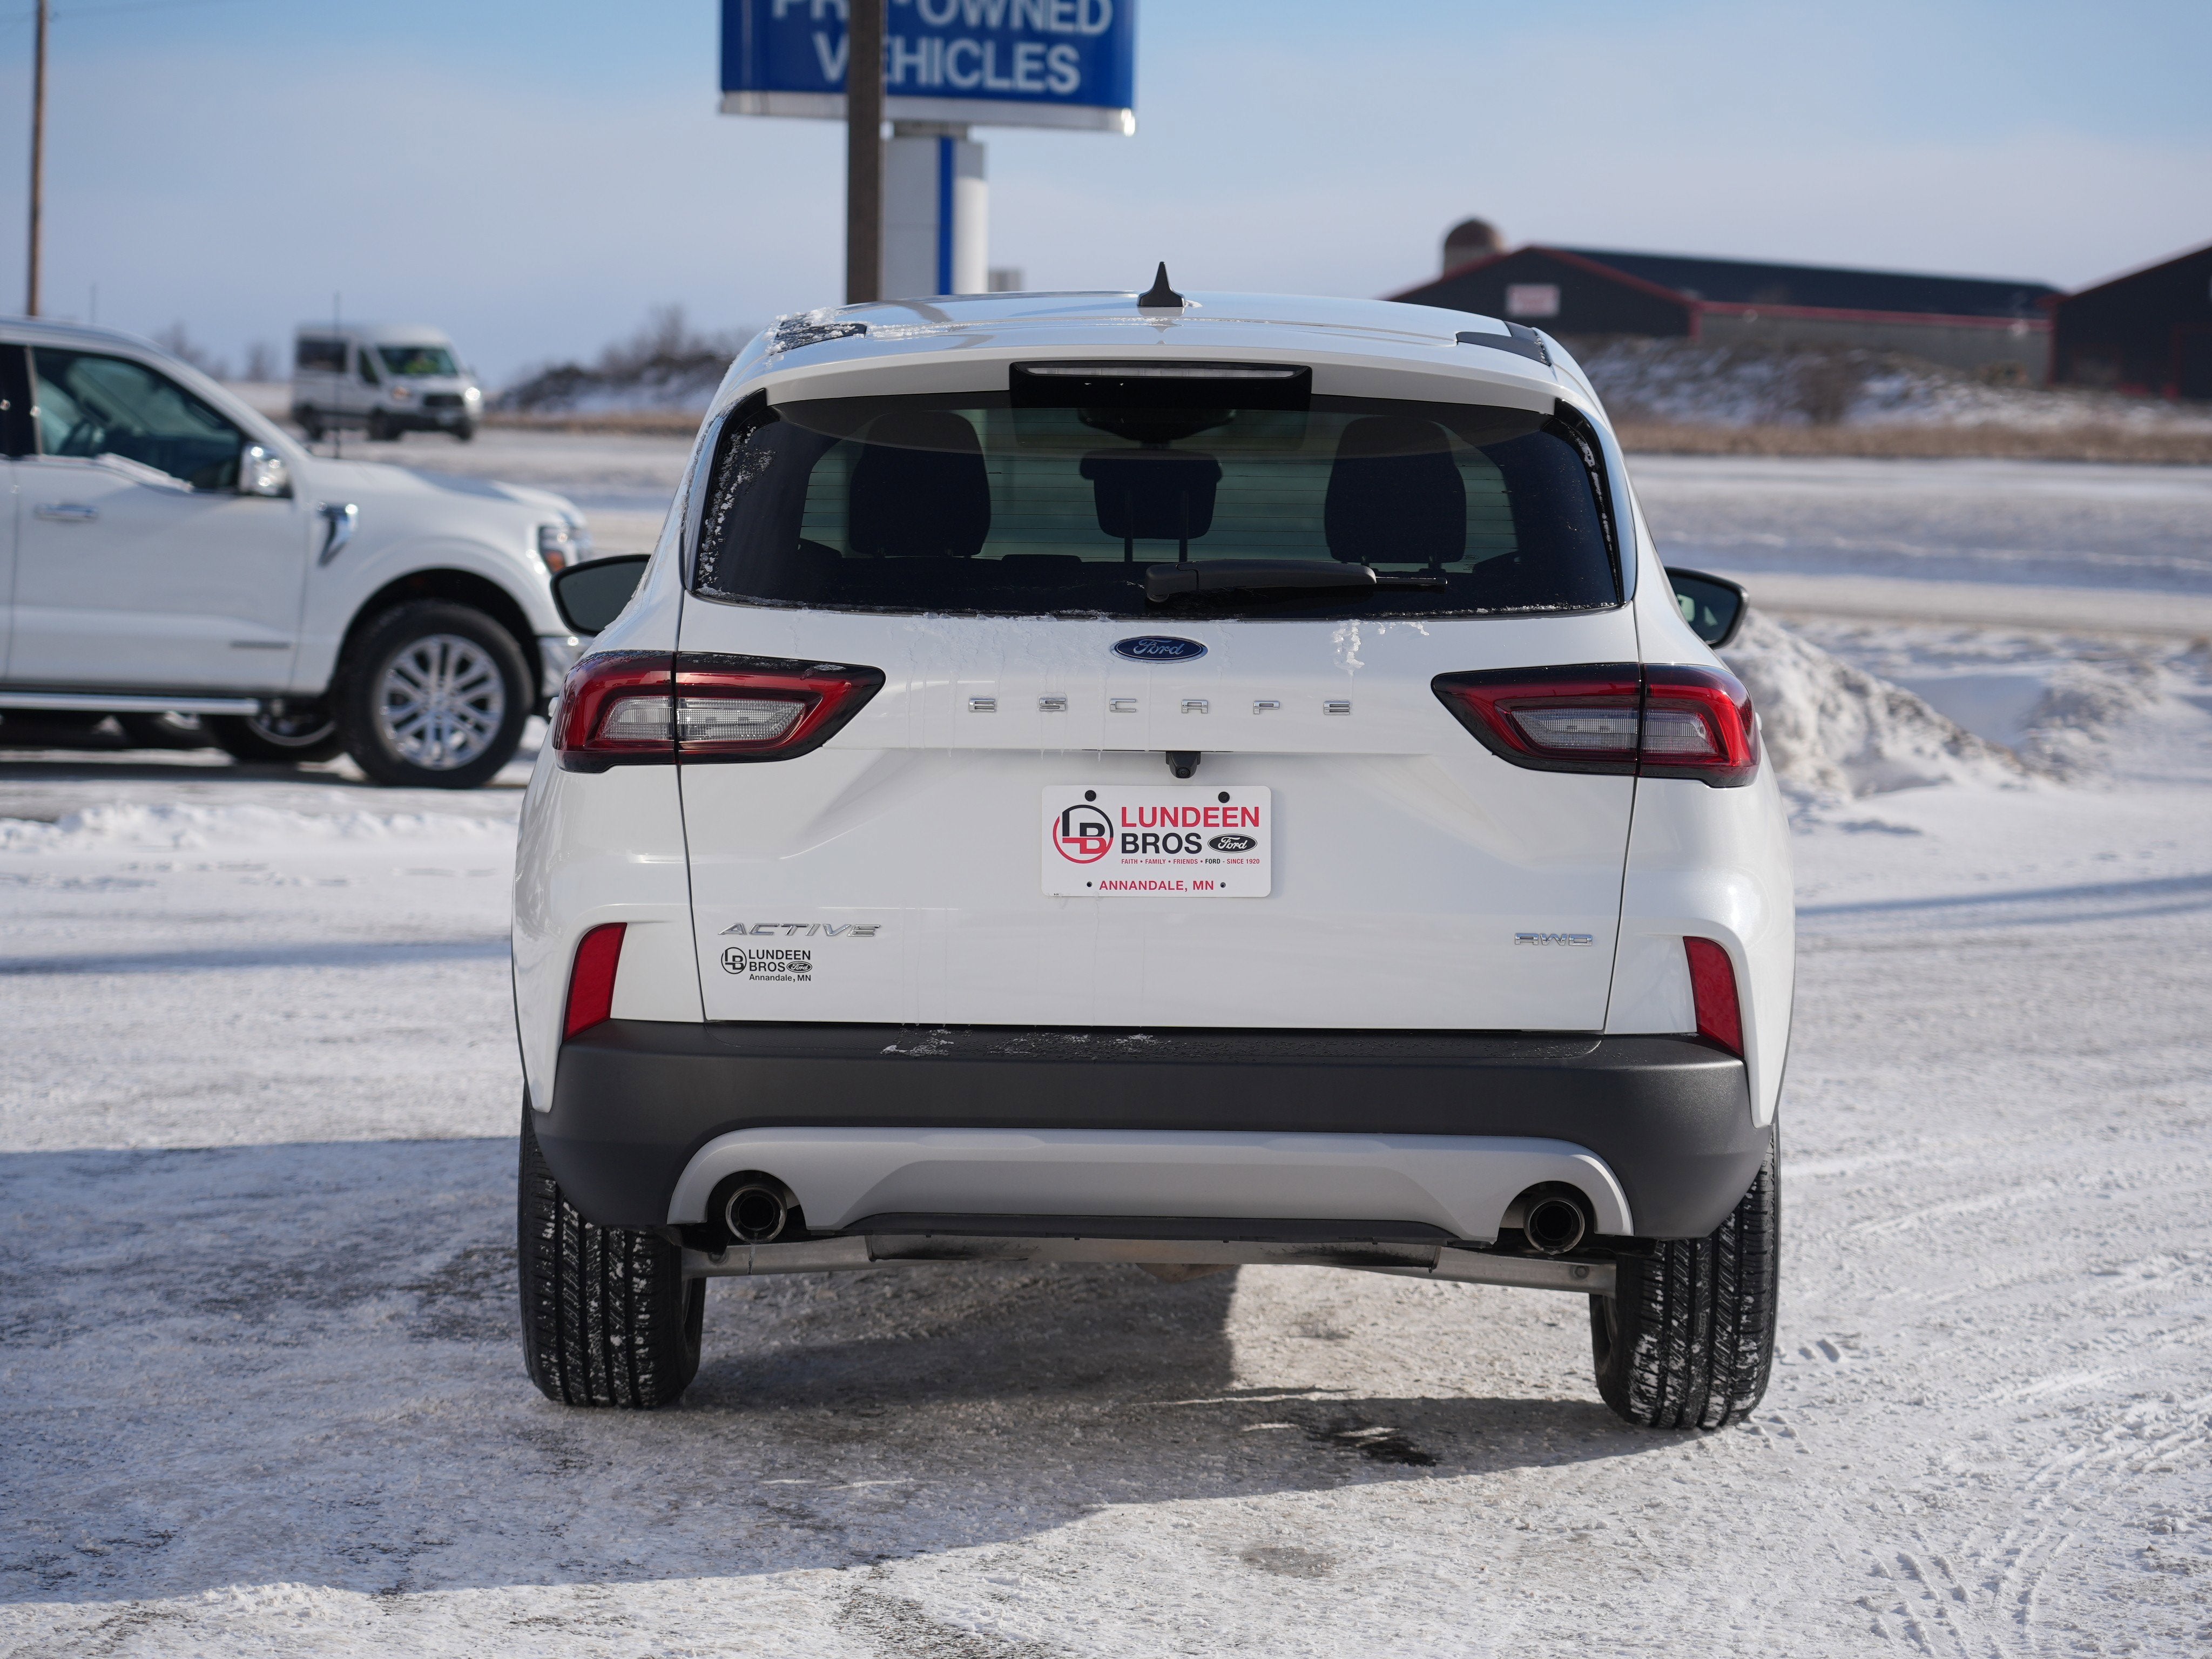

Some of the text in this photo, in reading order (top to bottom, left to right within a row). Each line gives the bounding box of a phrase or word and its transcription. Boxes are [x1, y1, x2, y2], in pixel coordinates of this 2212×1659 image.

[968, 697, 1351, 715] ESCAPE
[1121, 806, 1260, 828] LUNDEEN
[1121, 833, 1203, 854] BROS
[1099, 880, 1215, 892] ANNANDALE, MN
[717, 922, 882, 937] ACTIVE
[1514, 933, 1593, 947] AWD
[748, 949, 811, 960] LUNDEEN
[749, 961, 785, 972] BROS
[749, 974, 795, 982] Annandale,
